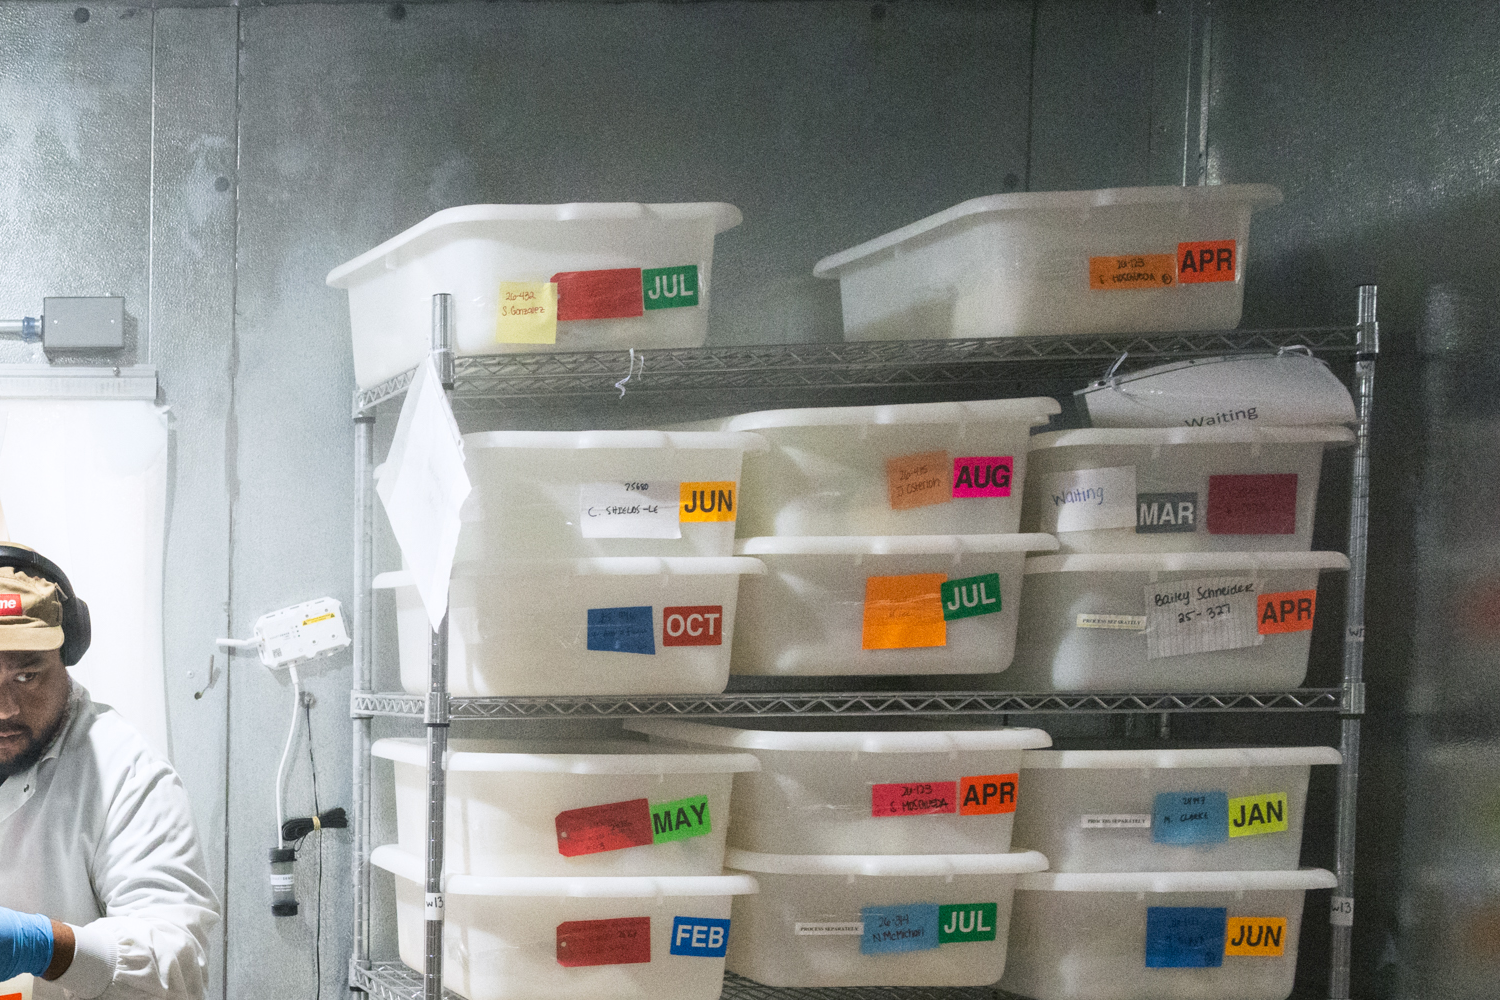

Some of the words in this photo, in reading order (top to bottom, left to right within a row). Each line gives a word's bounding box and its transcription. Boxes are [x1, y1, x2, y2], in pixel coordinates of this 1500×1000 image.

[1181, 249, 1232, 273] APR
[648, 274, 694, 299] JUL
[1185, 407, 1259, 427] Waiting
[955, 464, 1010, 489] AUG
[684, 490, 732, 513] JUN
[1051, 486, 1105, 506] Waiting
[1139, 502, 1194, 526] MAR
[948, 582, 996, 610] JUL
[1154, 590, 1190, 607] Bailey
[1261, 598, 1312, 625] APR
[666, 613, 720, 637] OCT
[963, 782, 1015, 806] APR
[653, 803, 706, 834] MAY
[1233, 800, 1283, 827] JAN
[944, 910, 991, 933] JUL
[676, 925, 724, 948] FEB
[1231, 925, 1282, 947] JUN
